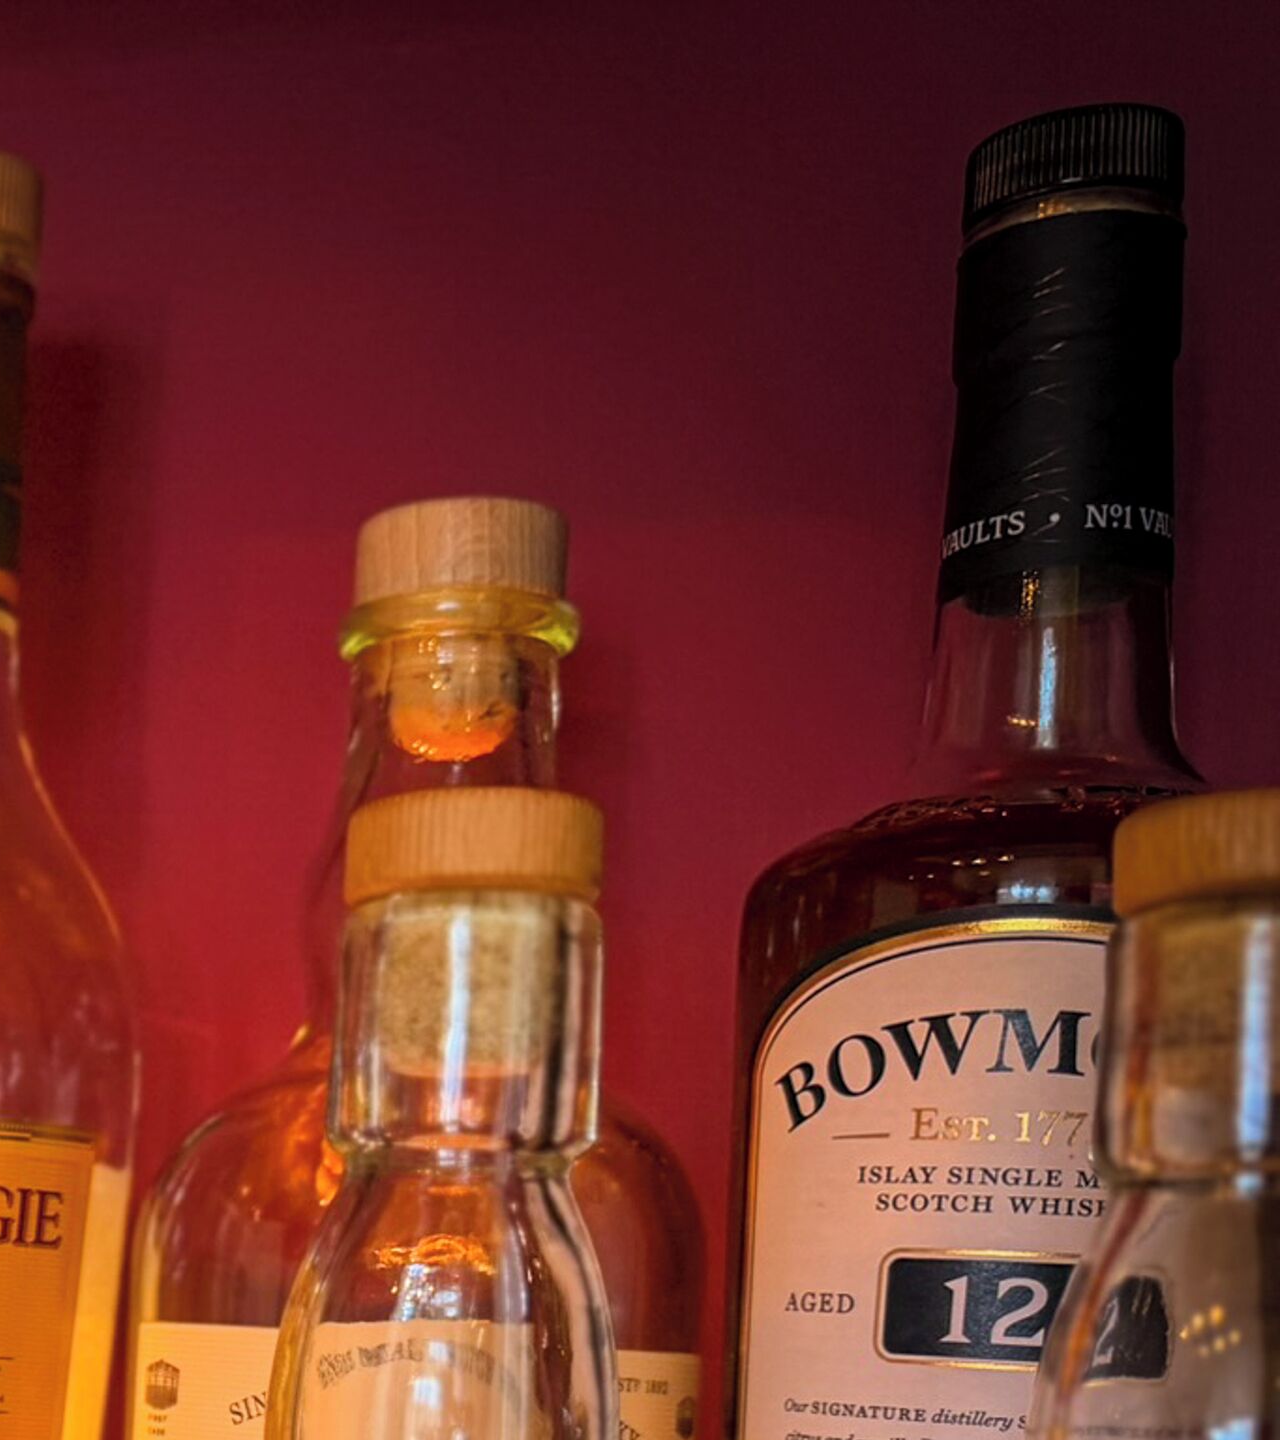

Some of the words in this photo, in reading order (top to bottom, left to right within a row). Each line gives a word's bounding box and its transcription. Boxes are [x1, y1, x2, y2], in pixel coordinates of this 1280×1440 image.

[775, 1007, 1100, 1134] BOWM
[857, 1166, 937, 1185] ISLAY
[946, 1165, 1063, 1189] SINGLE
[875, 1193, 993, 1214] SCOTCH
[785, 1292, 855, 1315] AGED
[939, 1275, 1048, 1347] 12
[784, 1397, 809, 1414] Our
[811, 1401, 927, 1424] SIGNATURE
[931, 1408, 1014, 1432] distillery
